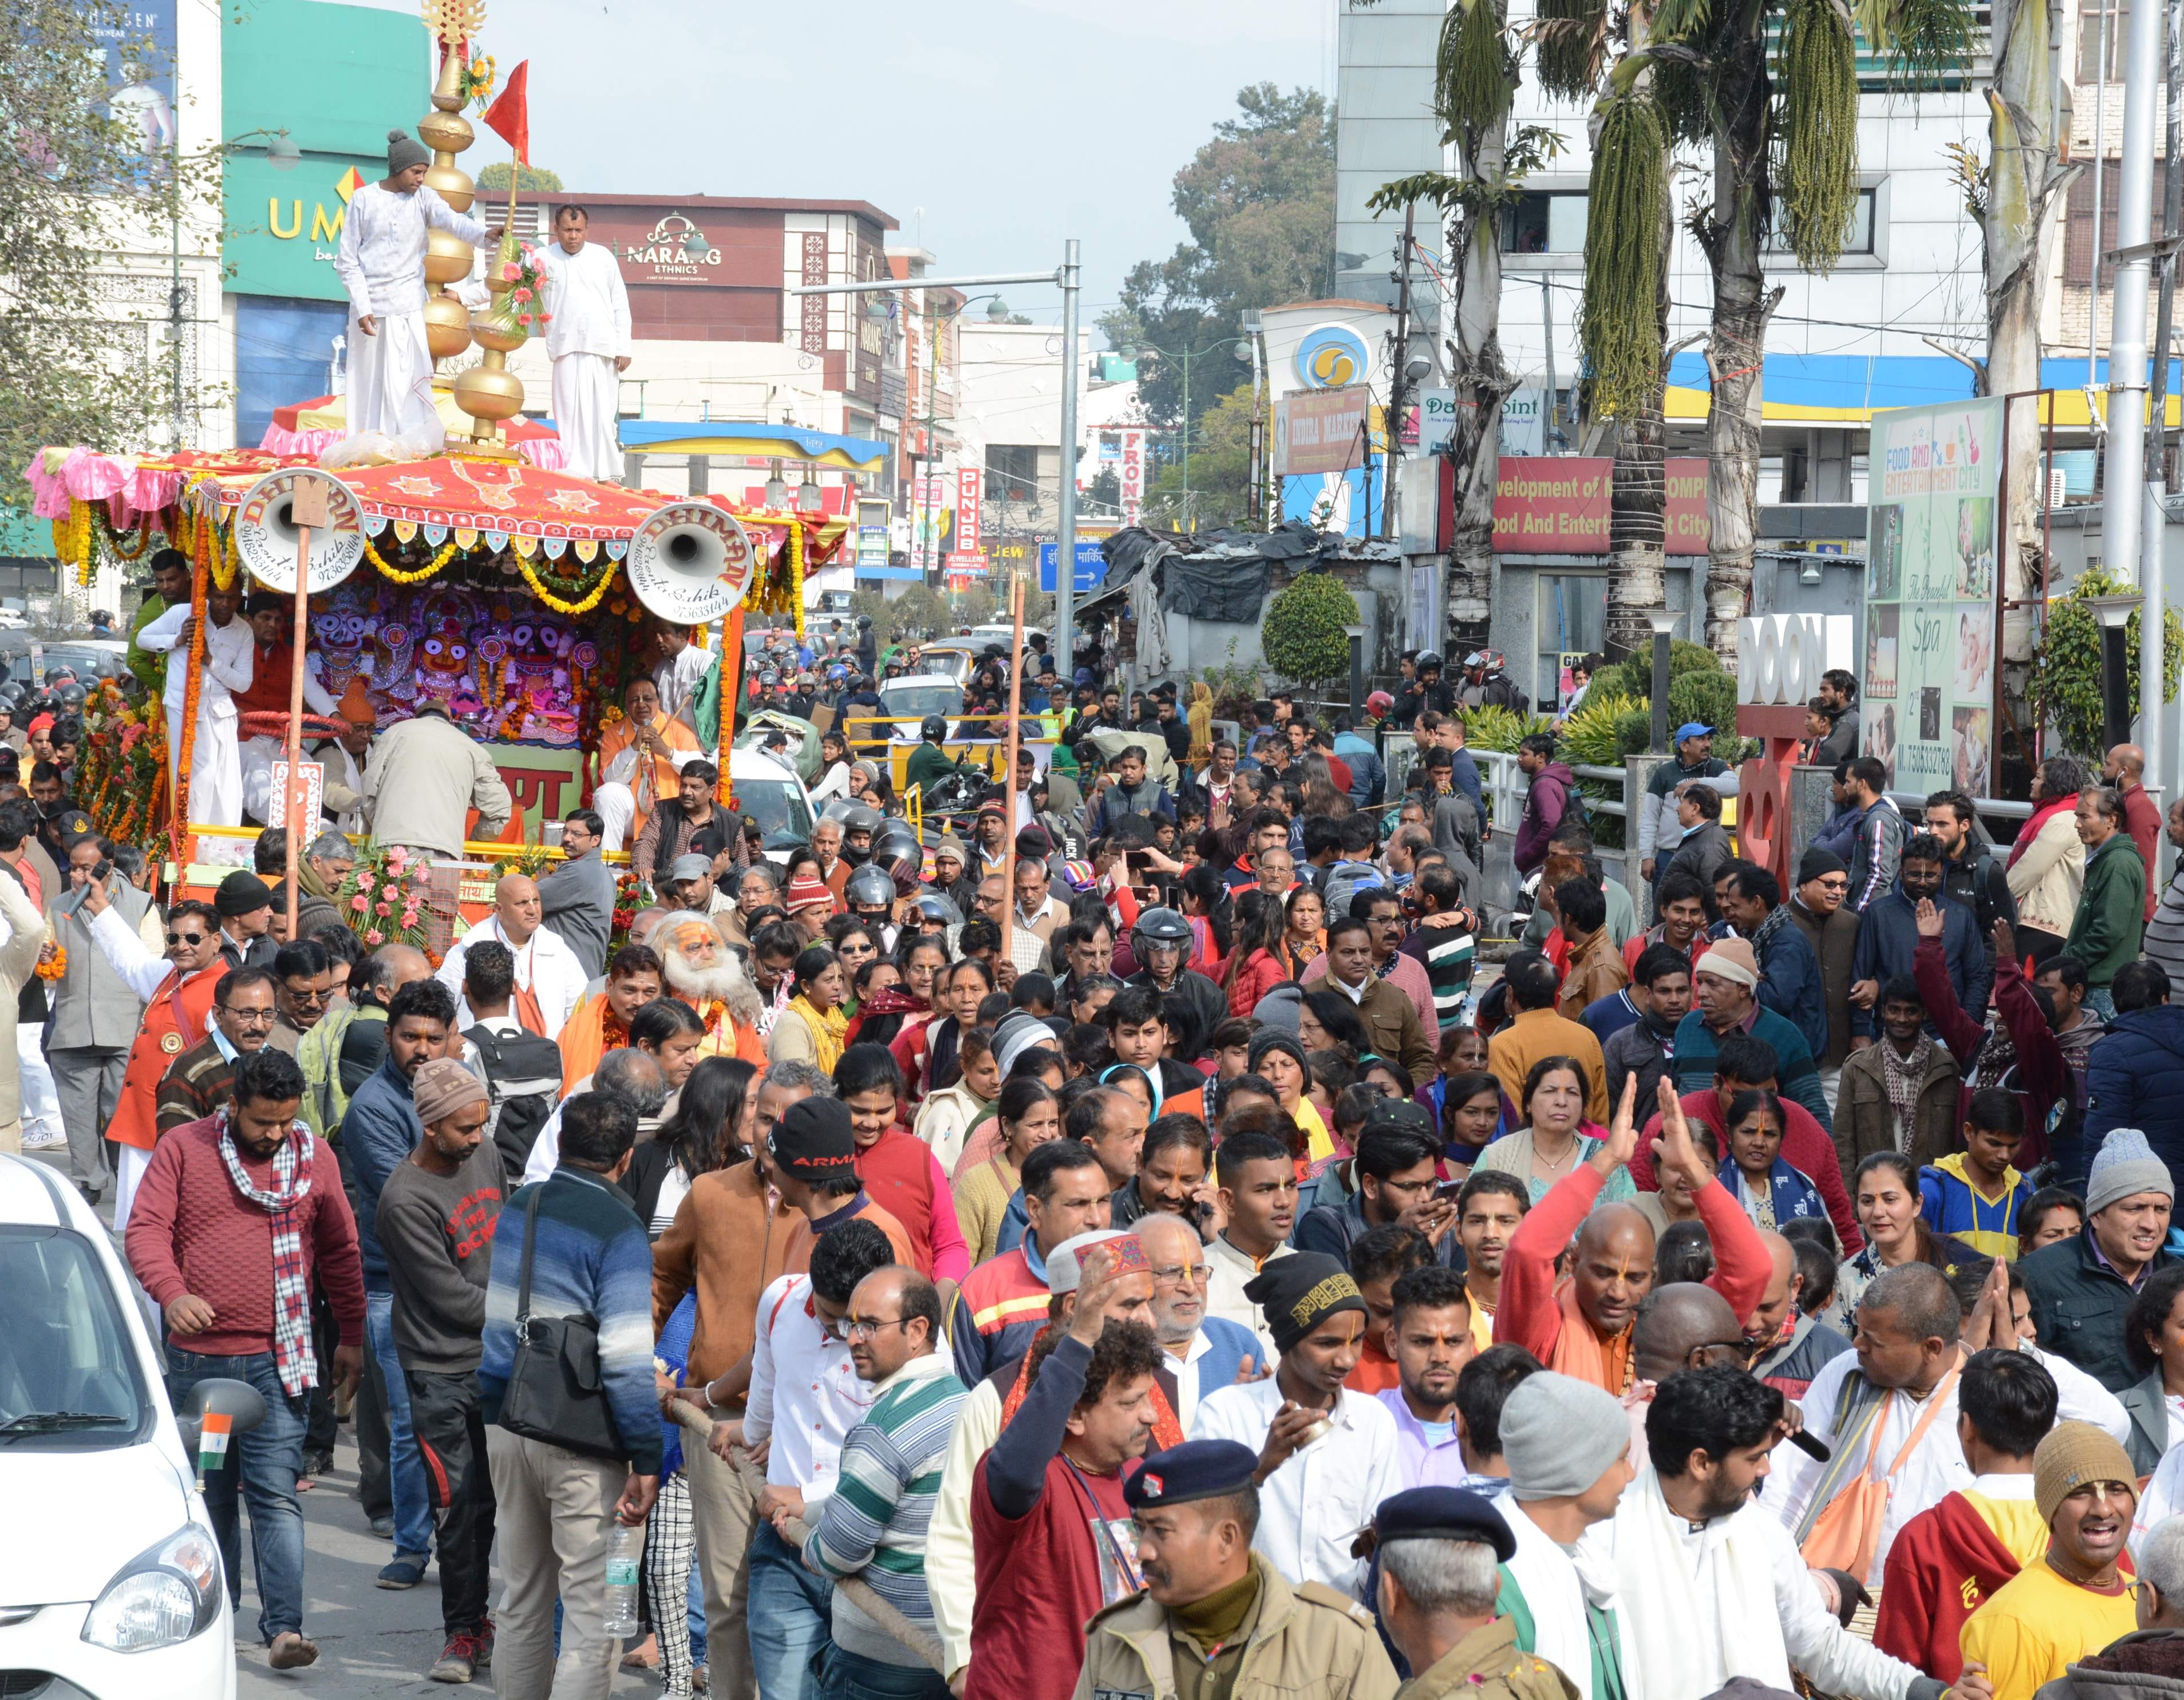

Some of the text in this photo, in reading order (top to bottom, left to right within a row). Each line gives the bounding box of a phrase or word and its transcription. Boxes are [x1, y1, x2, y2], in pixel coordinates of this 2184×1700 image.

[627, 247, 721, 265] NARAG
[654, 266, 698, 274] ETHNICS
[860, 320, 882, 356] NARANG
[1501, 399, 1538, 414] oint
[1292, 417, 1319, 446] INDIRA
[1324, 411, 1361, 443] MARKET
[1886, 444, 1929, 472] FOOD AND
[917, 481, 942, 491] FACORY
[1496, 476, 1578, 503] velopment
[1583, 476, 1600, 497] of
[1885, 465, 1981, 496] ENTERTAINMENT CITY
[918, 491, 939, 500] OULET
[959, 472, 976, 550] PUNJAB
[1080, 531, 1112, 539] SERVICES
[1492, 512, 1518, 535] ood
[1523, 512, 1554, 535] And
[1678, 512, 1711, 541] City
[254, 527, 296, 572] Paonta
[641, 508, 748, 592] DHIMAN
[644, 545, 720, 603] Paonta Sahib
[1907, 574, 1953, 608] The Peaceful
[1912, 607, 1941, 665] Spa
[1737, 614, 1827, 706] DOON
[1897, 743, 1906, 772] M.
[1065, 837, 1077, 859] JACK
[1794, 1198, 1808, 1216] राधे
